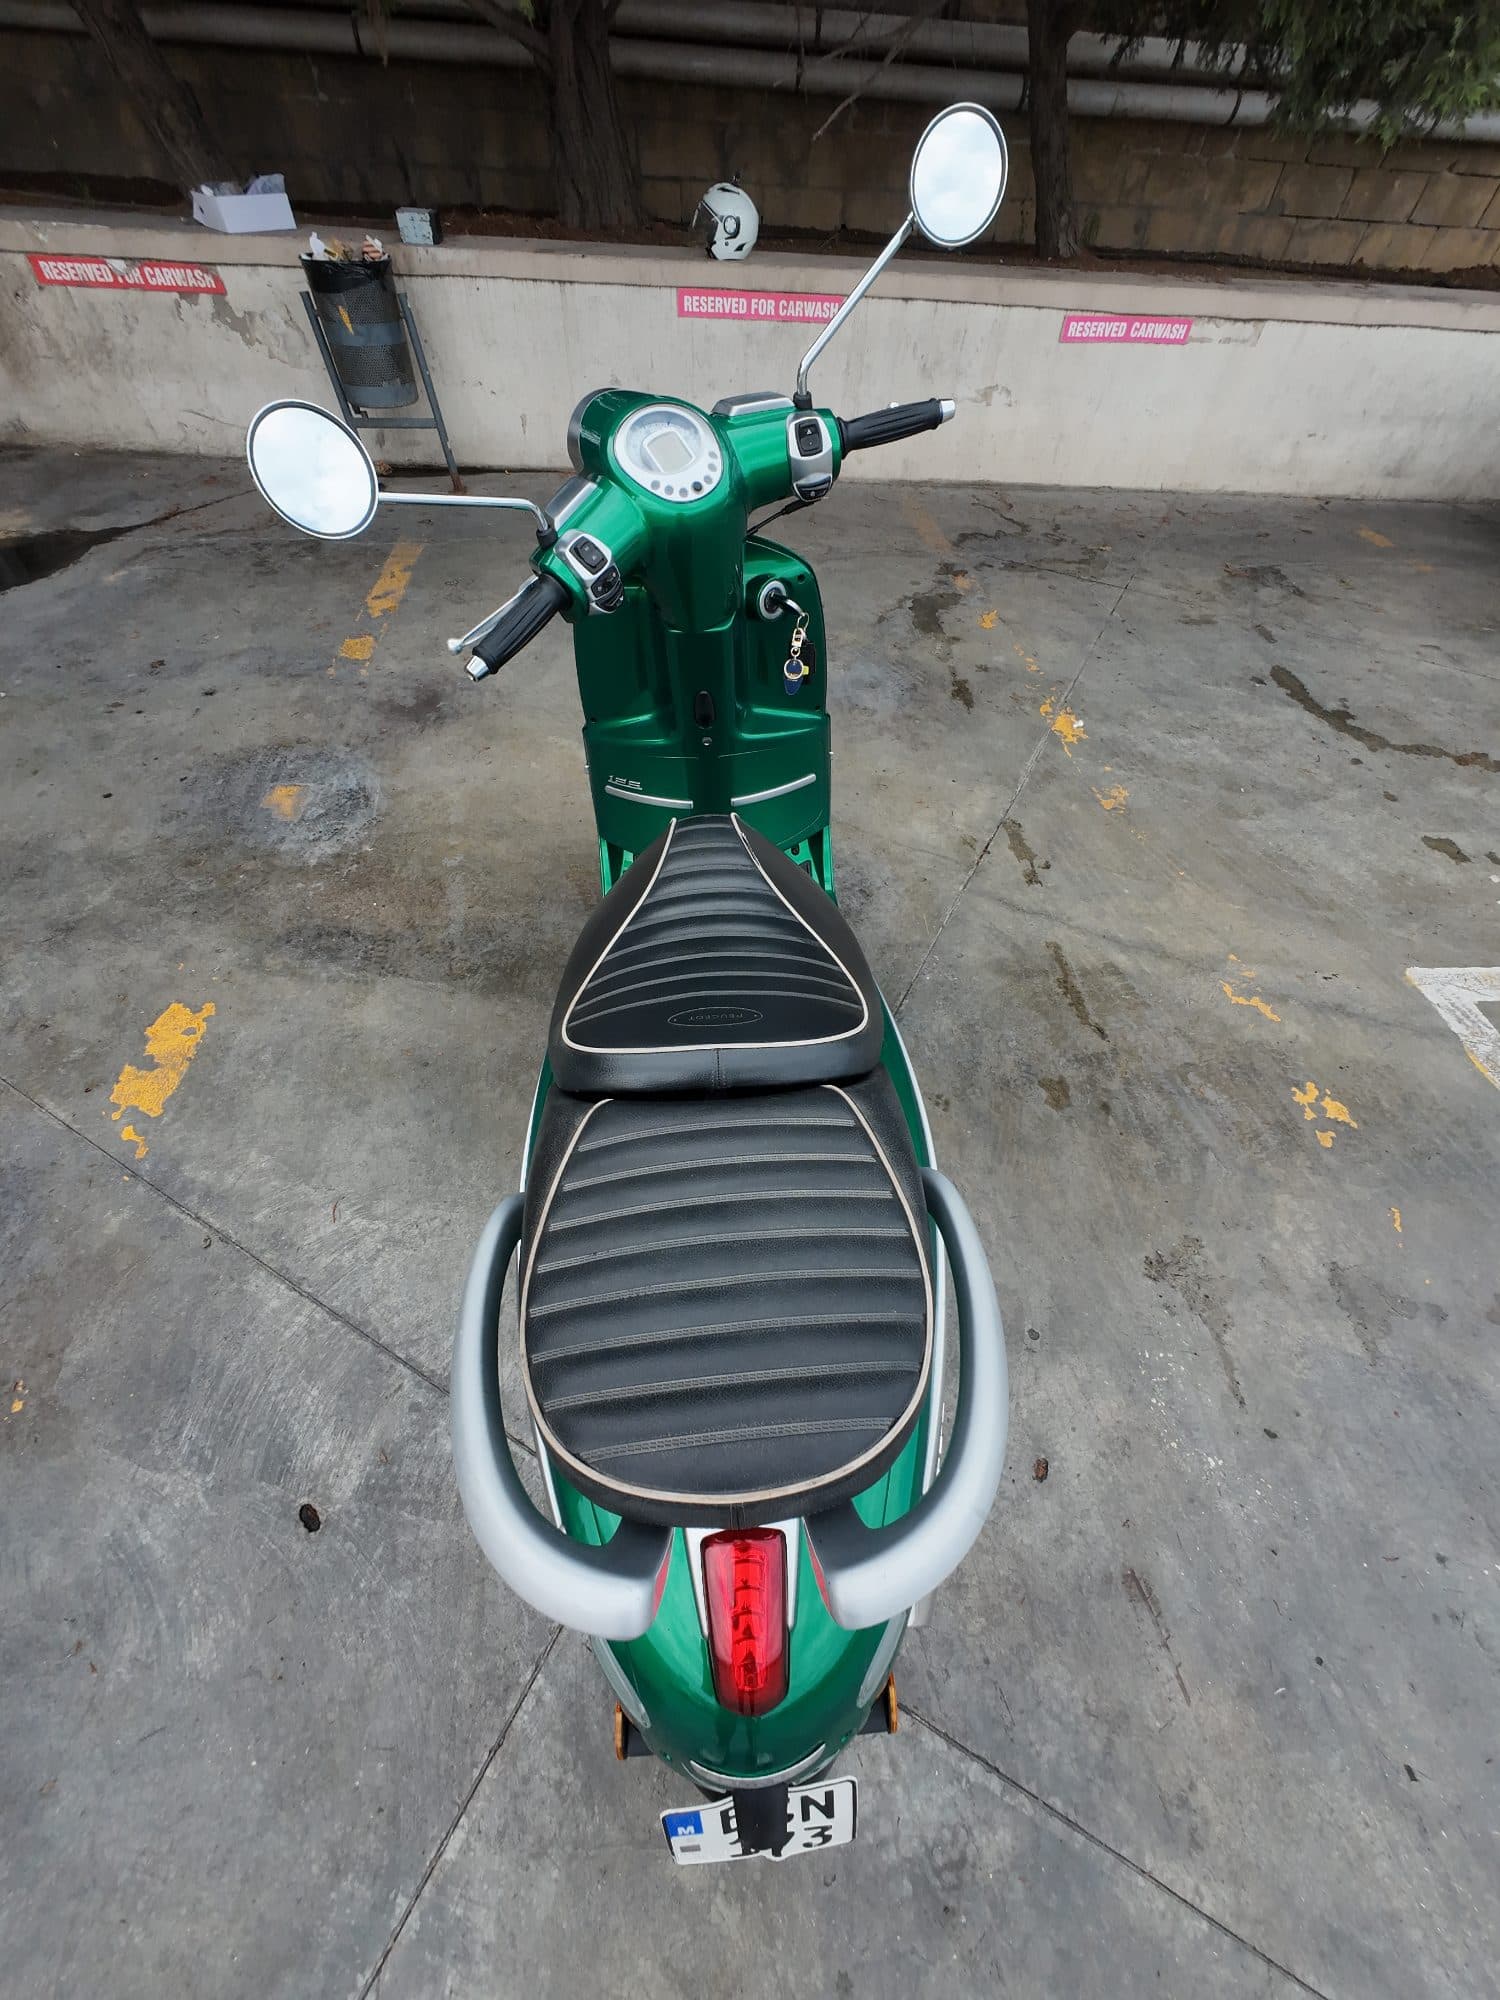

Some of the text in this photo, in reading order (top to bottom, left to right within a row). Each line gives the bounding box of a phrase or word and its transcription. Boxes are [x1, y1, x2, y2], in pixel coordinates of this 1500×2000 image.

[38, 260, 114, 283] RESERVED
[143, 266, 217, 289] CARWASH
[683, 295, 839, 319] RESERVED FOR CARWASH
[1067, 321, 1187, 340] RESERVED CARWASH
